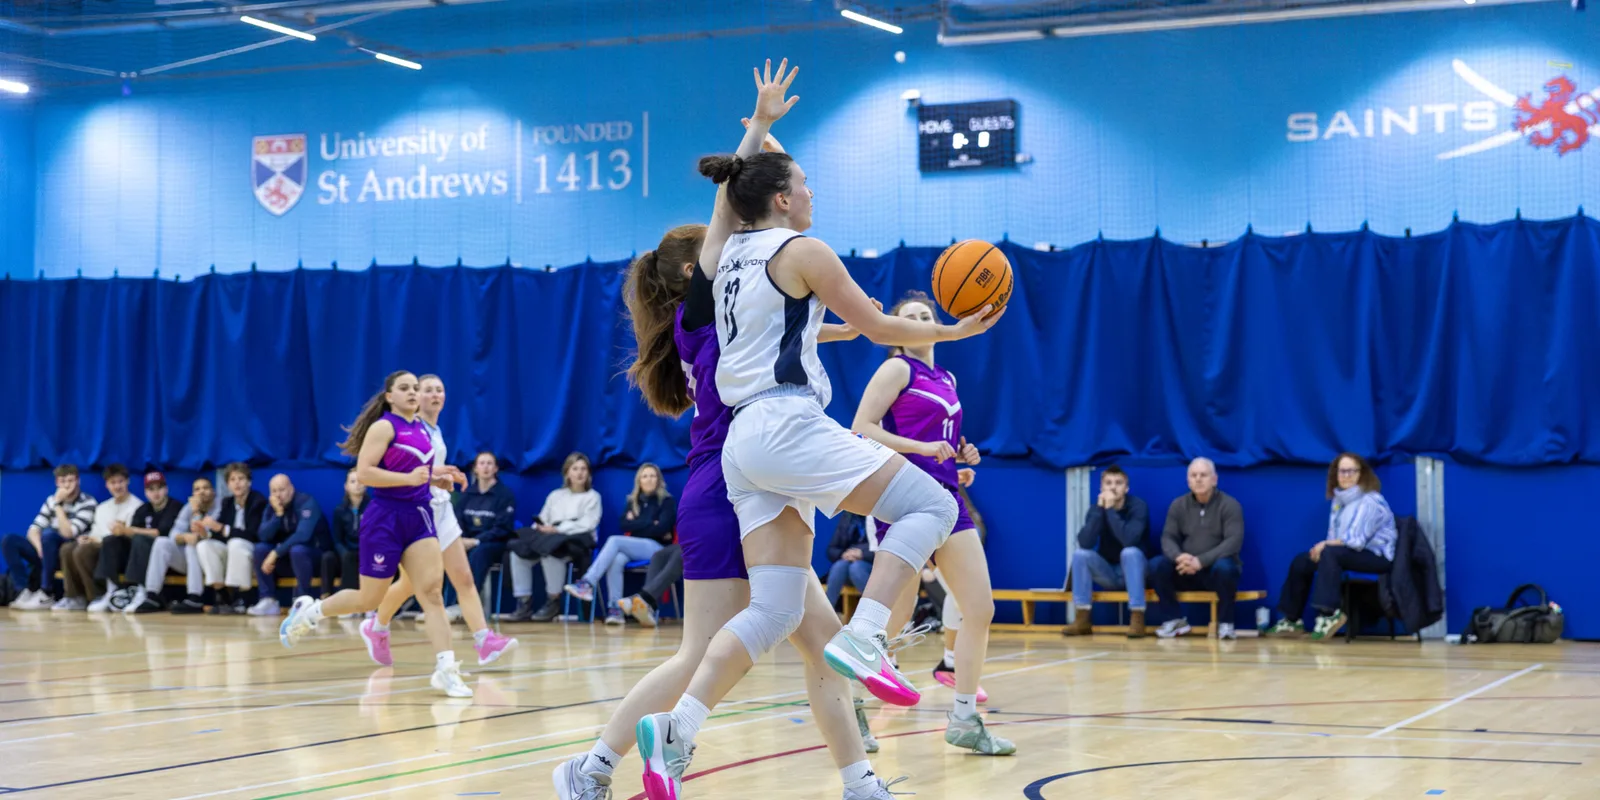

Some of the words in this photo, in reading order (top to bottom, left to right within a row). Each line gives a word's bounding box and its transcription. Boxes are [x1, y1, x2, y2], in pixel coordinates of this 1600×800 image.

[533, 120, 634, 146] FOUNDED
[968, 115, 1015, 132] GUESTS
[1286, 100, 1498, 142] SAINTS
[320, 127, 454, 162] University
[460, 124, 489, 152] of
[317, 169, 351, 205] St
[358, 164, 508, 203] Andrews
[533, 148, 633, 195] 1413
[975, 267, 992, 287] FIBA
[942, 417, 955, 440] 11
